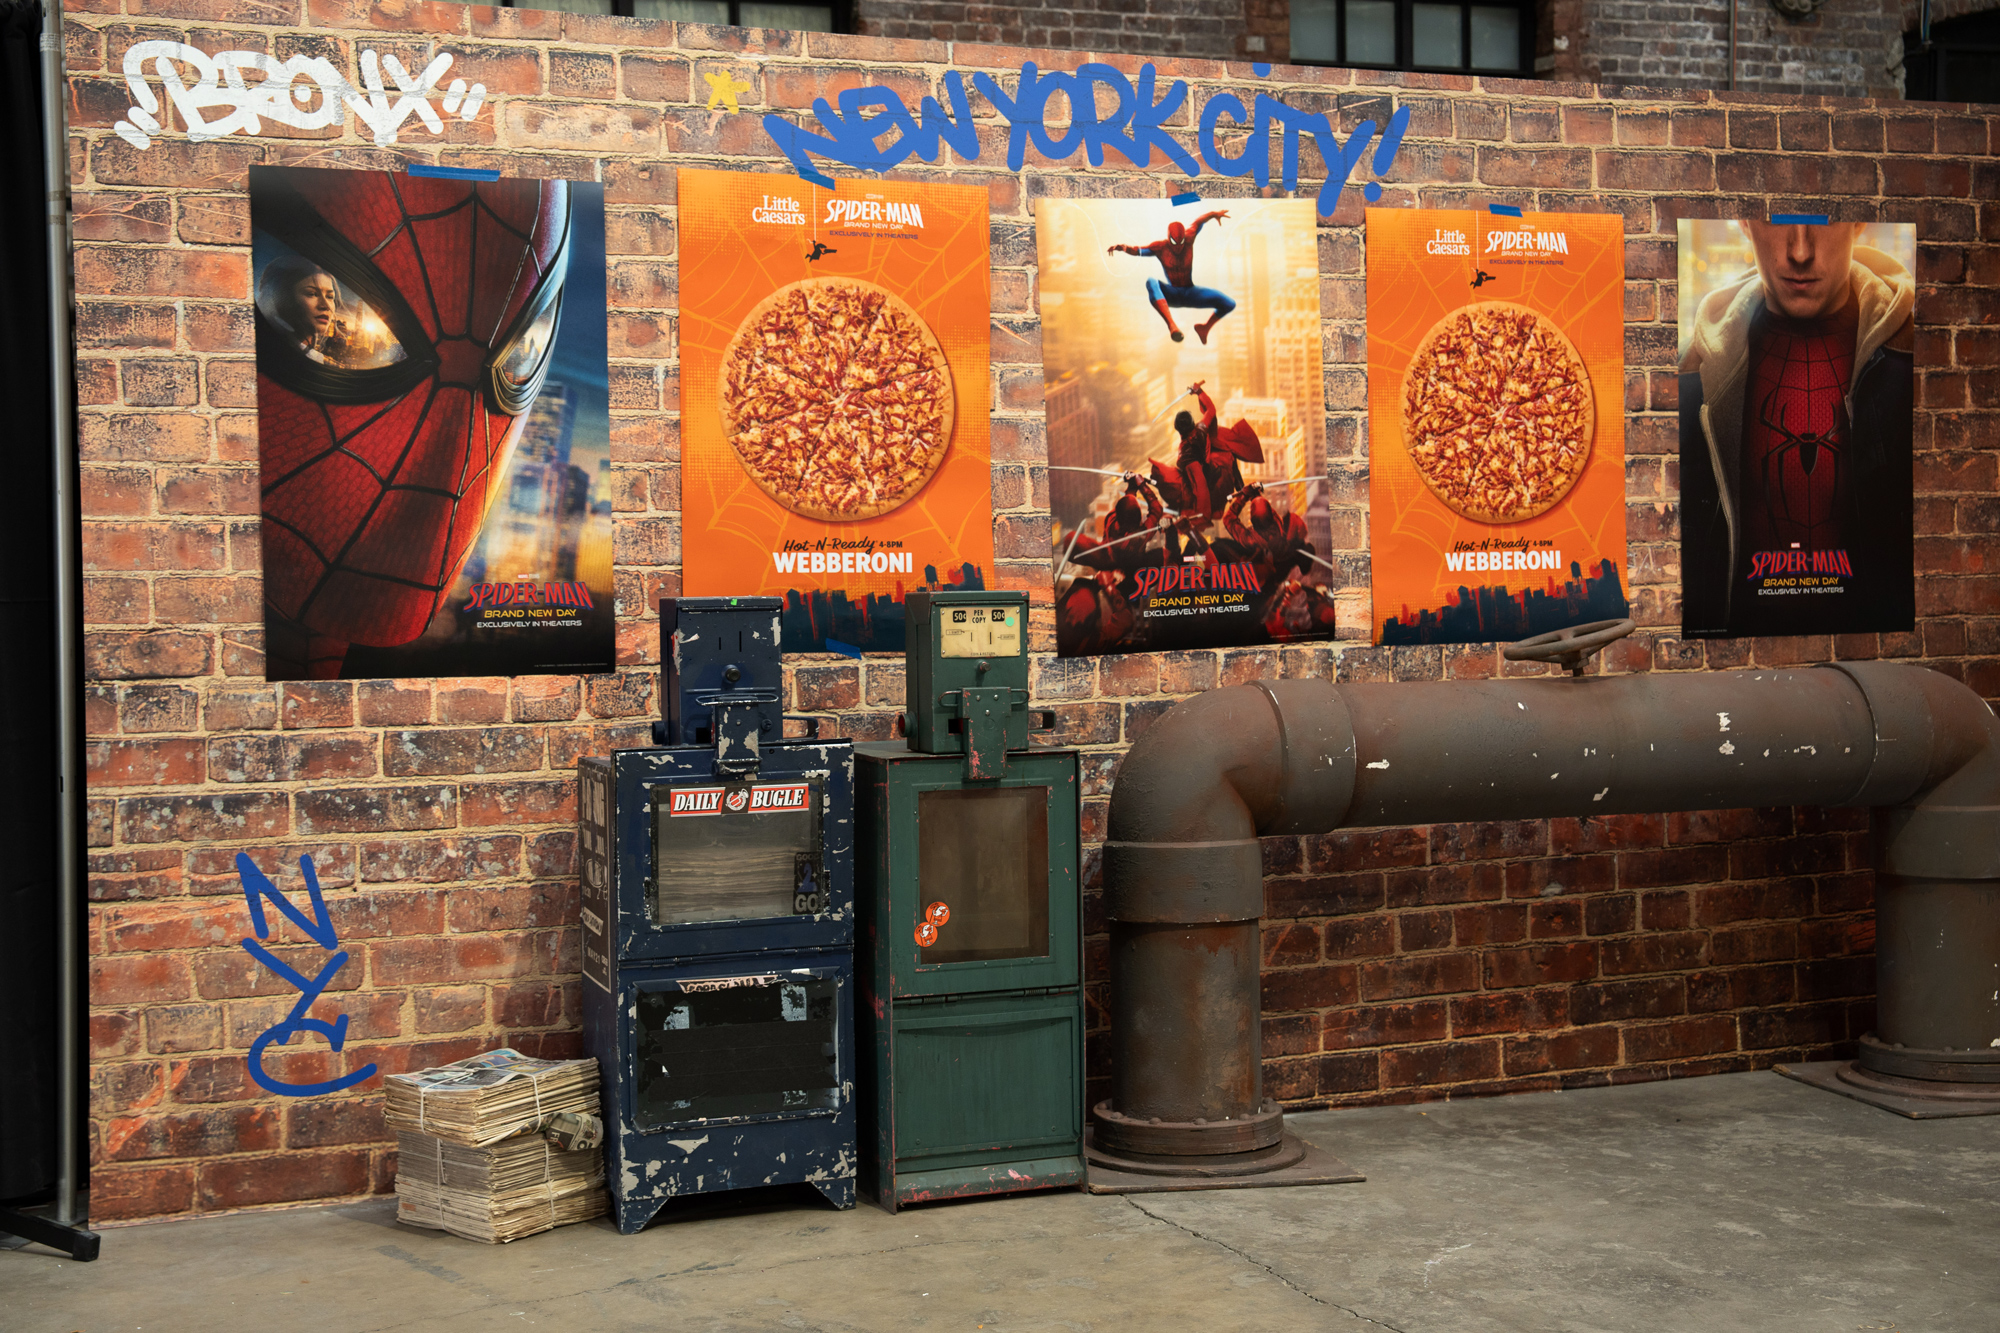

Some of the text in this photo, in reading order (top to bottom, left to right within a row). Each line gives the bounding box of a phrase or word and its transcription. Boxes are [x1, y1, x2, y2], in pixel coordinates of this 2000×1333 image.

[763, 69, 980, 174] NEW
[973, 61, 1200, 178] YORK
[763, 195, 800, 212] Little
[752, 206, 806, 225] Caesars
[824, 199, 924, 229] SPIDER-MAN
[829, 230, 875, 238] EXCLUSIVELY
[844, 221, 870, 229] BRAND
[1435, 229, 1465, 243] Little
[1485, 231, 1568, 255] SPIDER-MAN
[1426, 240, 1470, 255] Caesars
[772, 552, 913, 573] WEBBERONI
[1445, 550, 1561, 572] WEBBERONI
[1747, 550, 1853, 581] SPIDER-MAN
[1128, 562, 1261, 601] SPIDER-MAN
[1763, 577, 1839, 587] BRAND NEW DAY
[463, 582, 594, 612] SPIDER-MAN
[1150, 594, 1244, 608] BRAND NEW DAY
[484, 610, 524, 618] BRAND
[528, 609, 552, 617] NEW
[1143, 608, 1198, 618] EXCLUSIVELY
[1209, 605, 1250, 613] THEATERS
[476, 620, 530, 628] EXCLUSIVELY
[673, 788, 806, 812] DAILY BUGLE
[797, 862, 818, 892] 2
[794, 894, 819, 913] GO
[235, 852, 377, 1097] NYC
